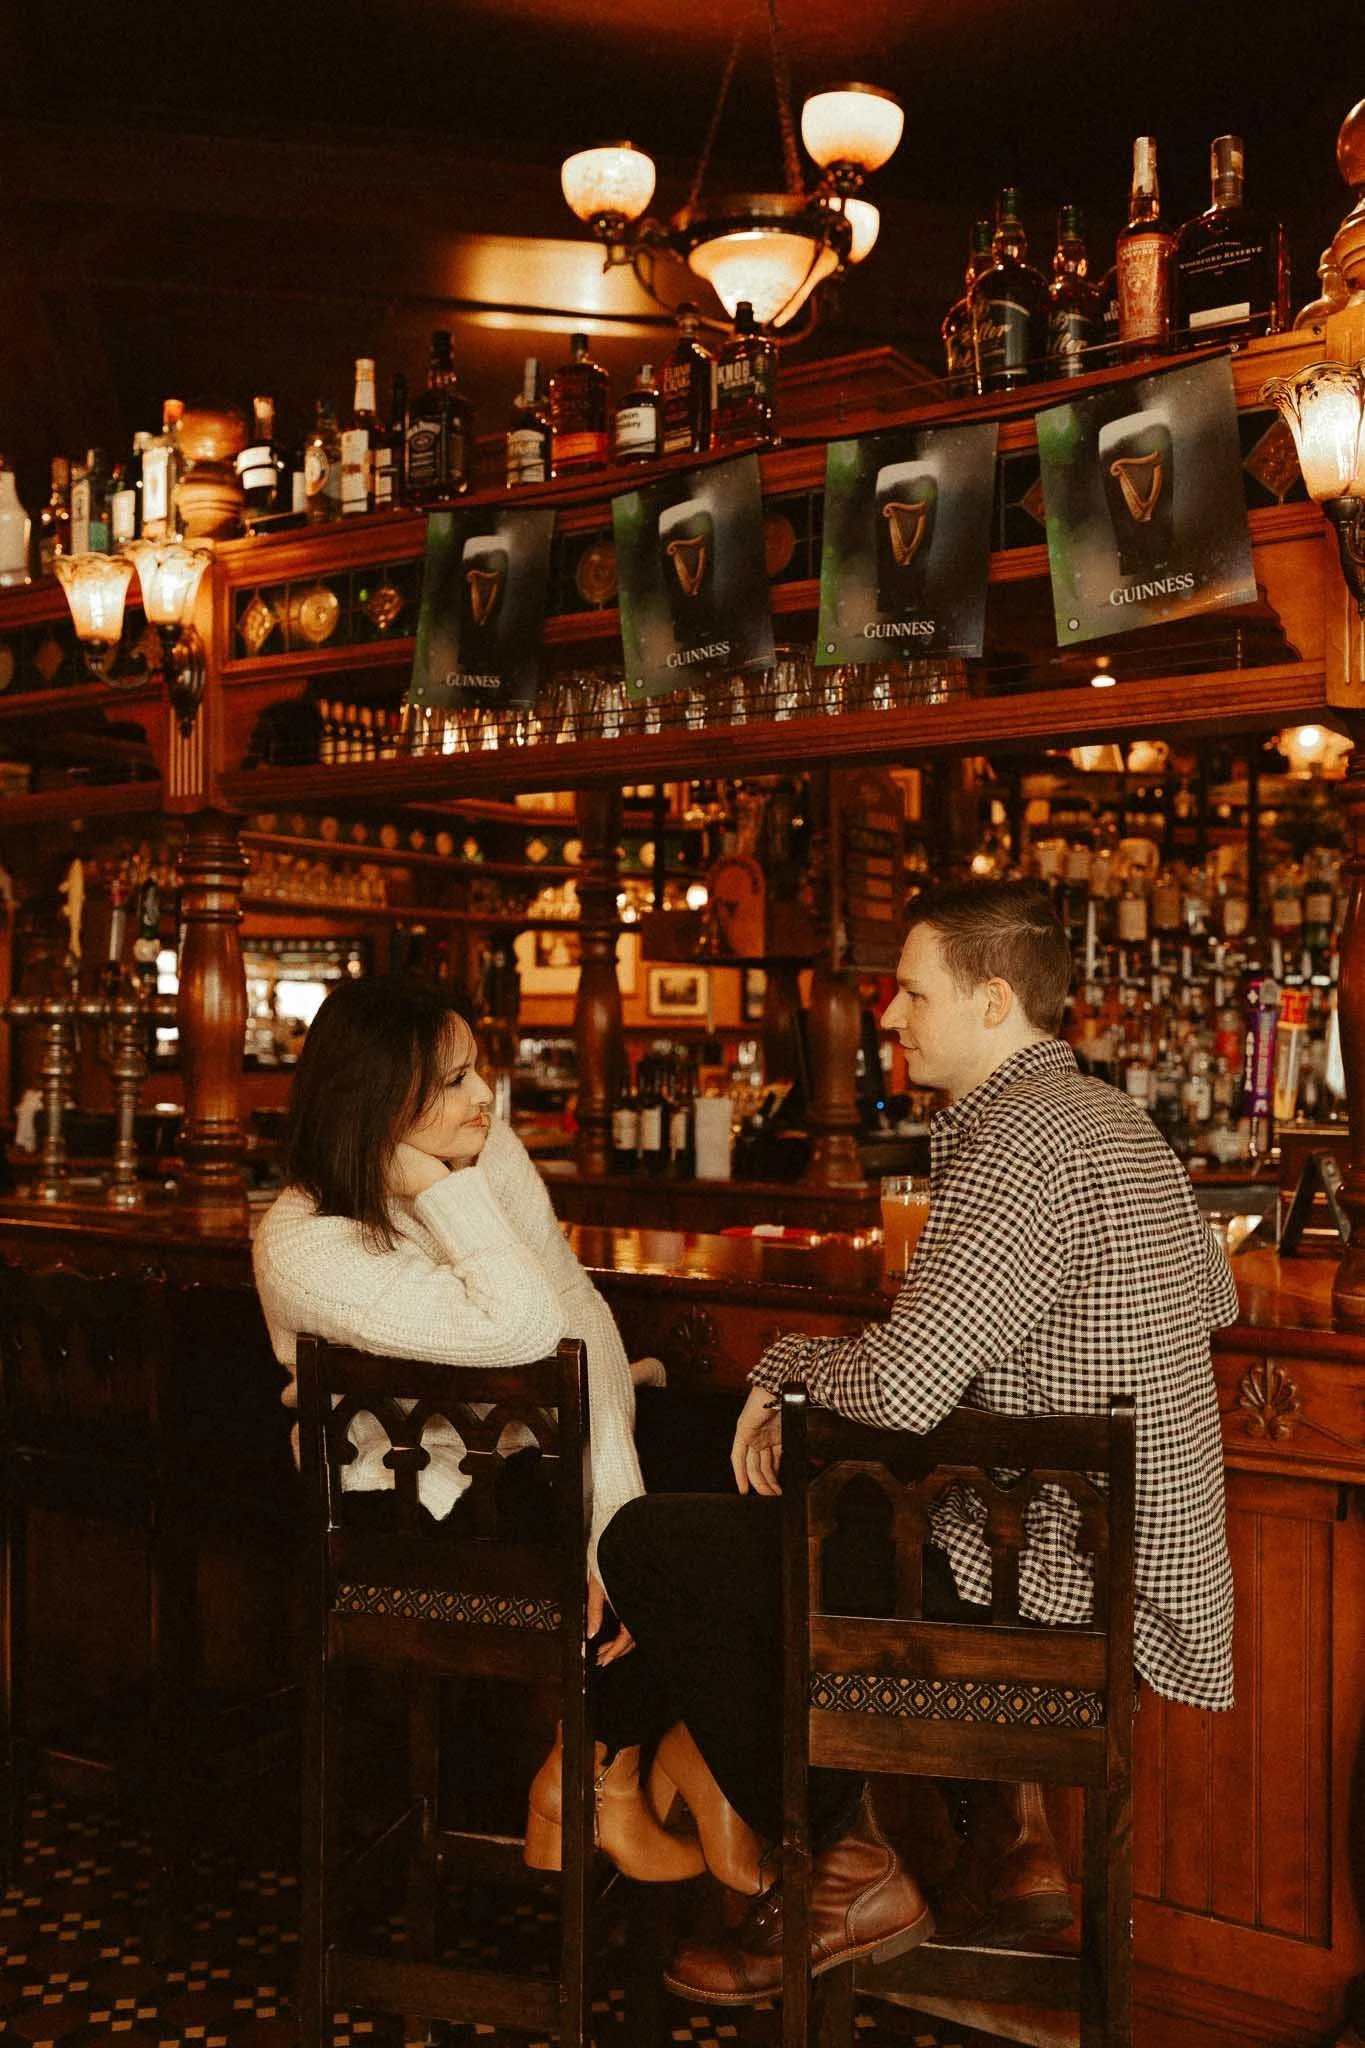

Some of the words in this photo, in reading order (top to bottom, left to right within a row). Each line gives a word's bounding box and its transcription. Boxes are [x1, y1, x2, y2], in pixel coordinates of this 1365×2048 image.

[718, 360, 750, 385] KNOB
[1109, 572, 1195, 606] GUINNESS
[863, 620, 936, 639] GUINNESS
[666, 640, 731, 669] GUINNESS
[446, 671, 501, 688] GUINNESS
